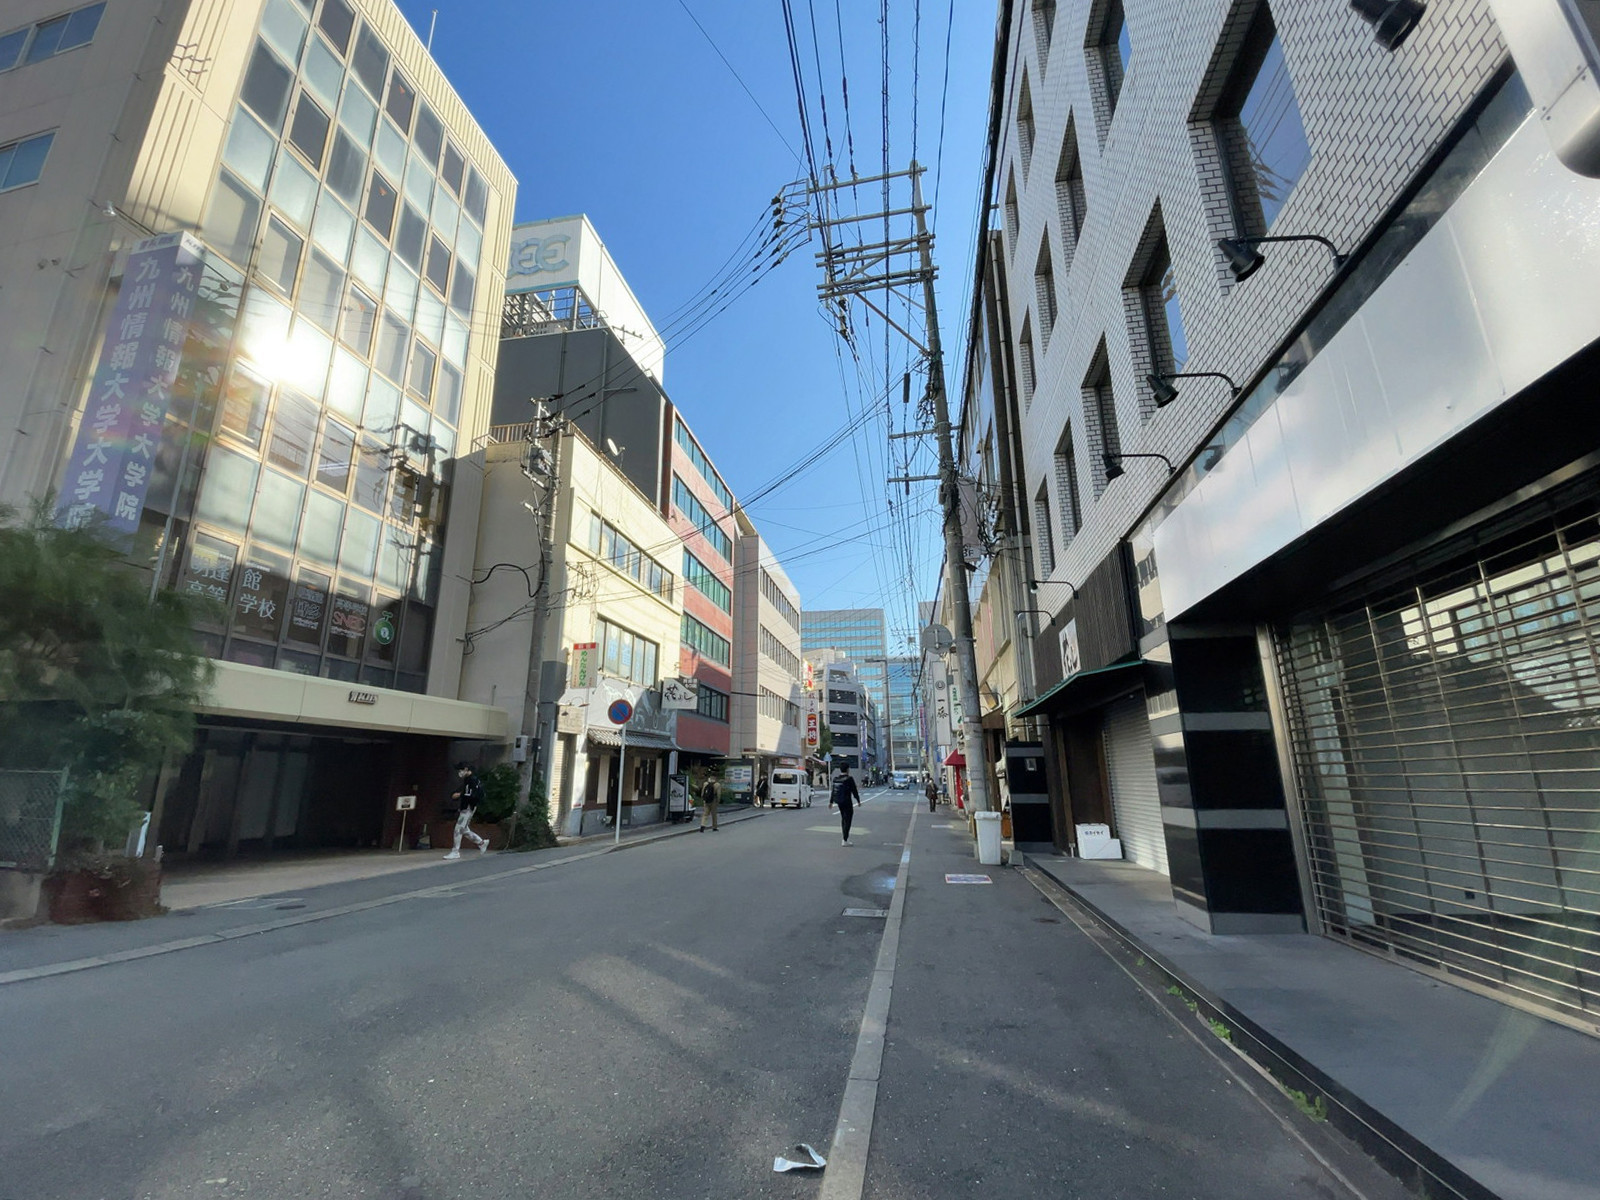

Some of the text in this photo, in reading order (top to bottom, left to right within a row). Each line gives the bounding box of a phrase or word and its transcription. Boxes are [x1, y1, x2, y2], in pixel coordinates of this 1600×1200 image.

[64, 256, 161, 530] 九州情報大学大学院
[115, 265, 195, 521] 九州情報大学大学院
